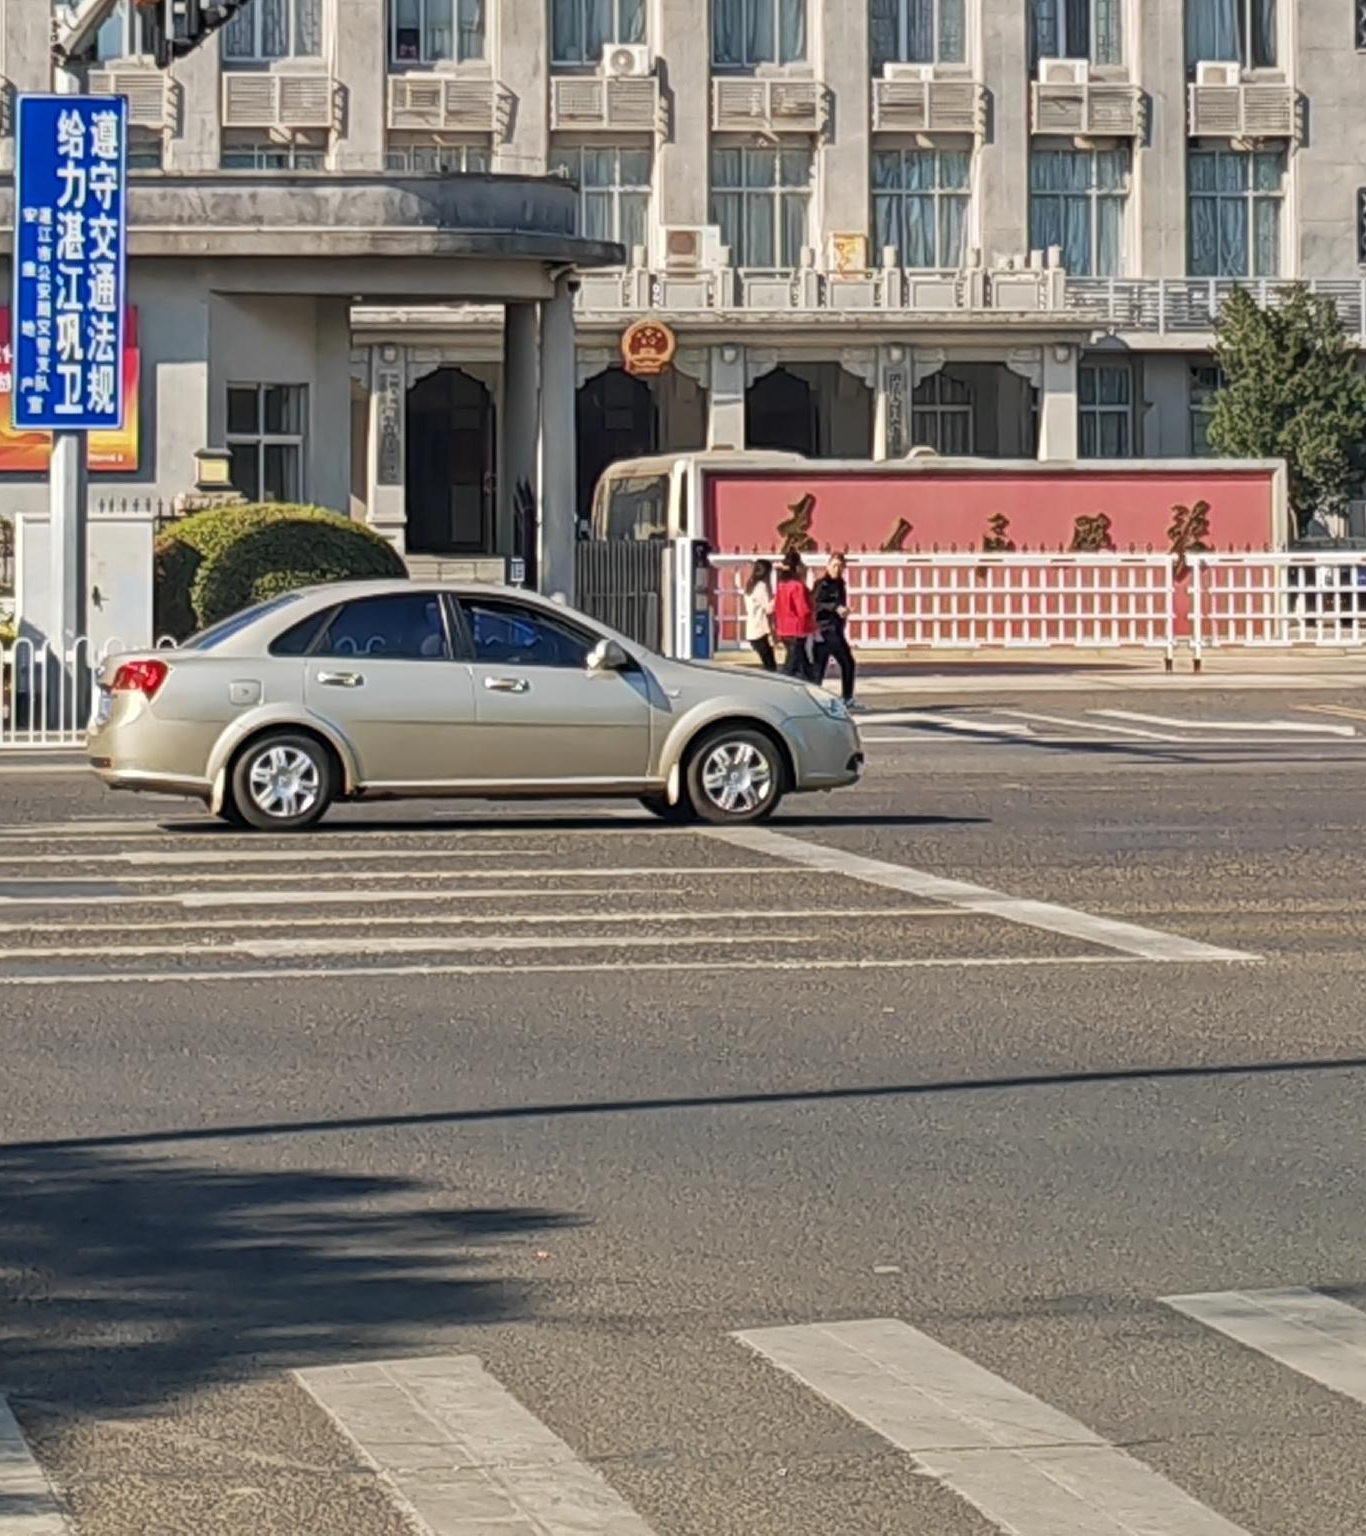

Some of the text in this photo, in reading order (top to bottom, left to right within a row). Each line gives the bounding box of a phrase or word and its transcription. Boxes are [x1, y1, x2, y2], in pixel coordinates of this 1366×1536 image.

[55, 109, 86, 414] 给力湛江巩卫
[87, 111, 118, 414] 遵守交通法规
